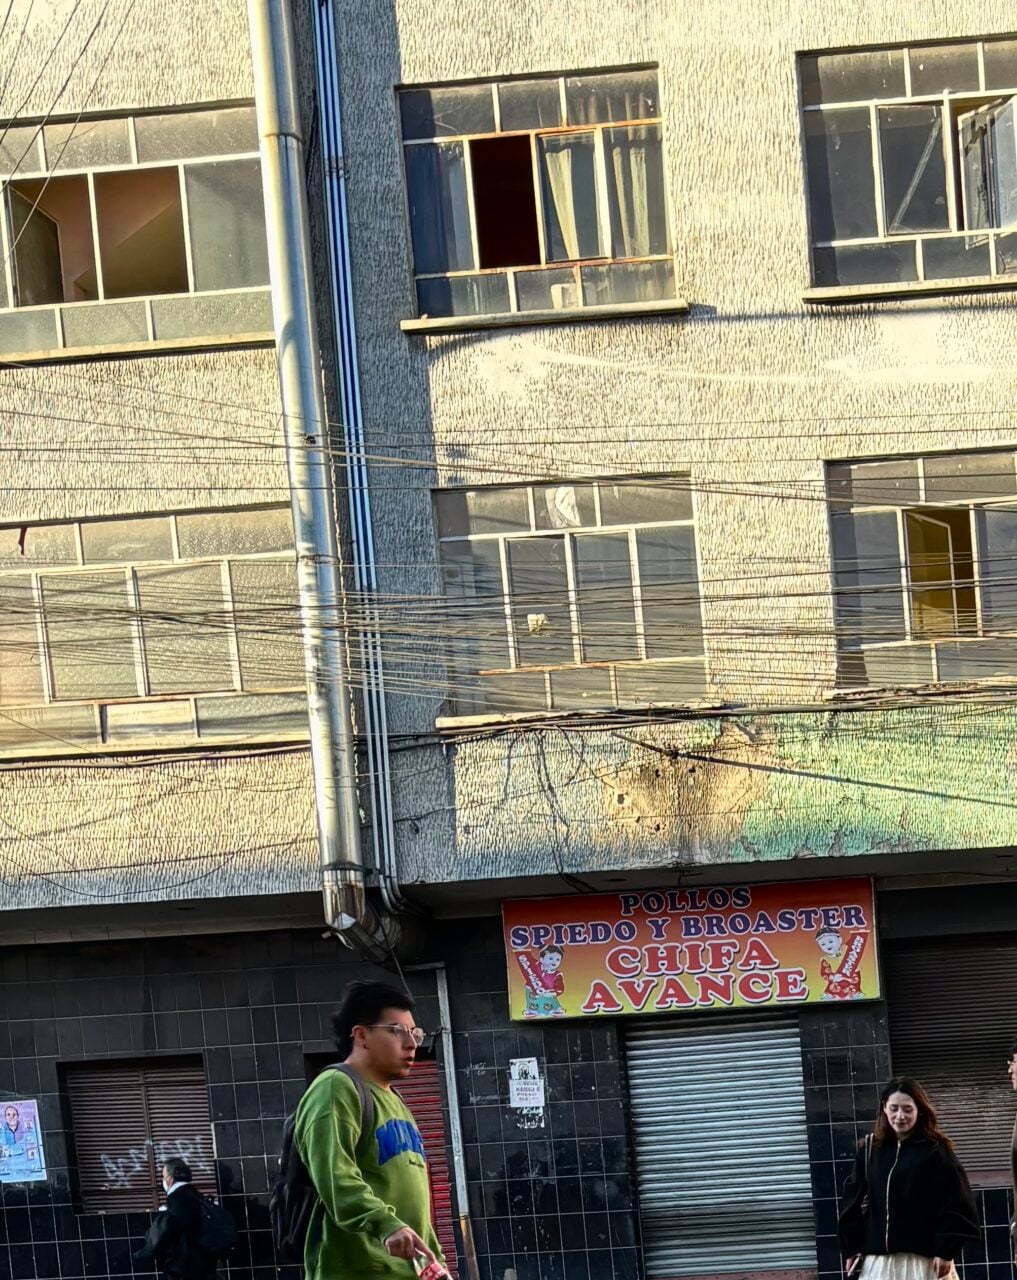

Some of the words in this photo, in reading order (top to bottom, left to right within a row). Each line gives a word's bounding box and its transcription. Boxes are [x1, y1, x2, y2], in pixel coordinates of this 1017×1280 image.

[619, 887, 752, 916] POLLOS
[510, 920, 637, 948] SPIEDO
[646, 917, 671, 940] Y
[681, 904, 868, 938] BROASTER
[606, 937, 780, 978] CHIFA
[581, 967, 810, 1015] AVANCE
